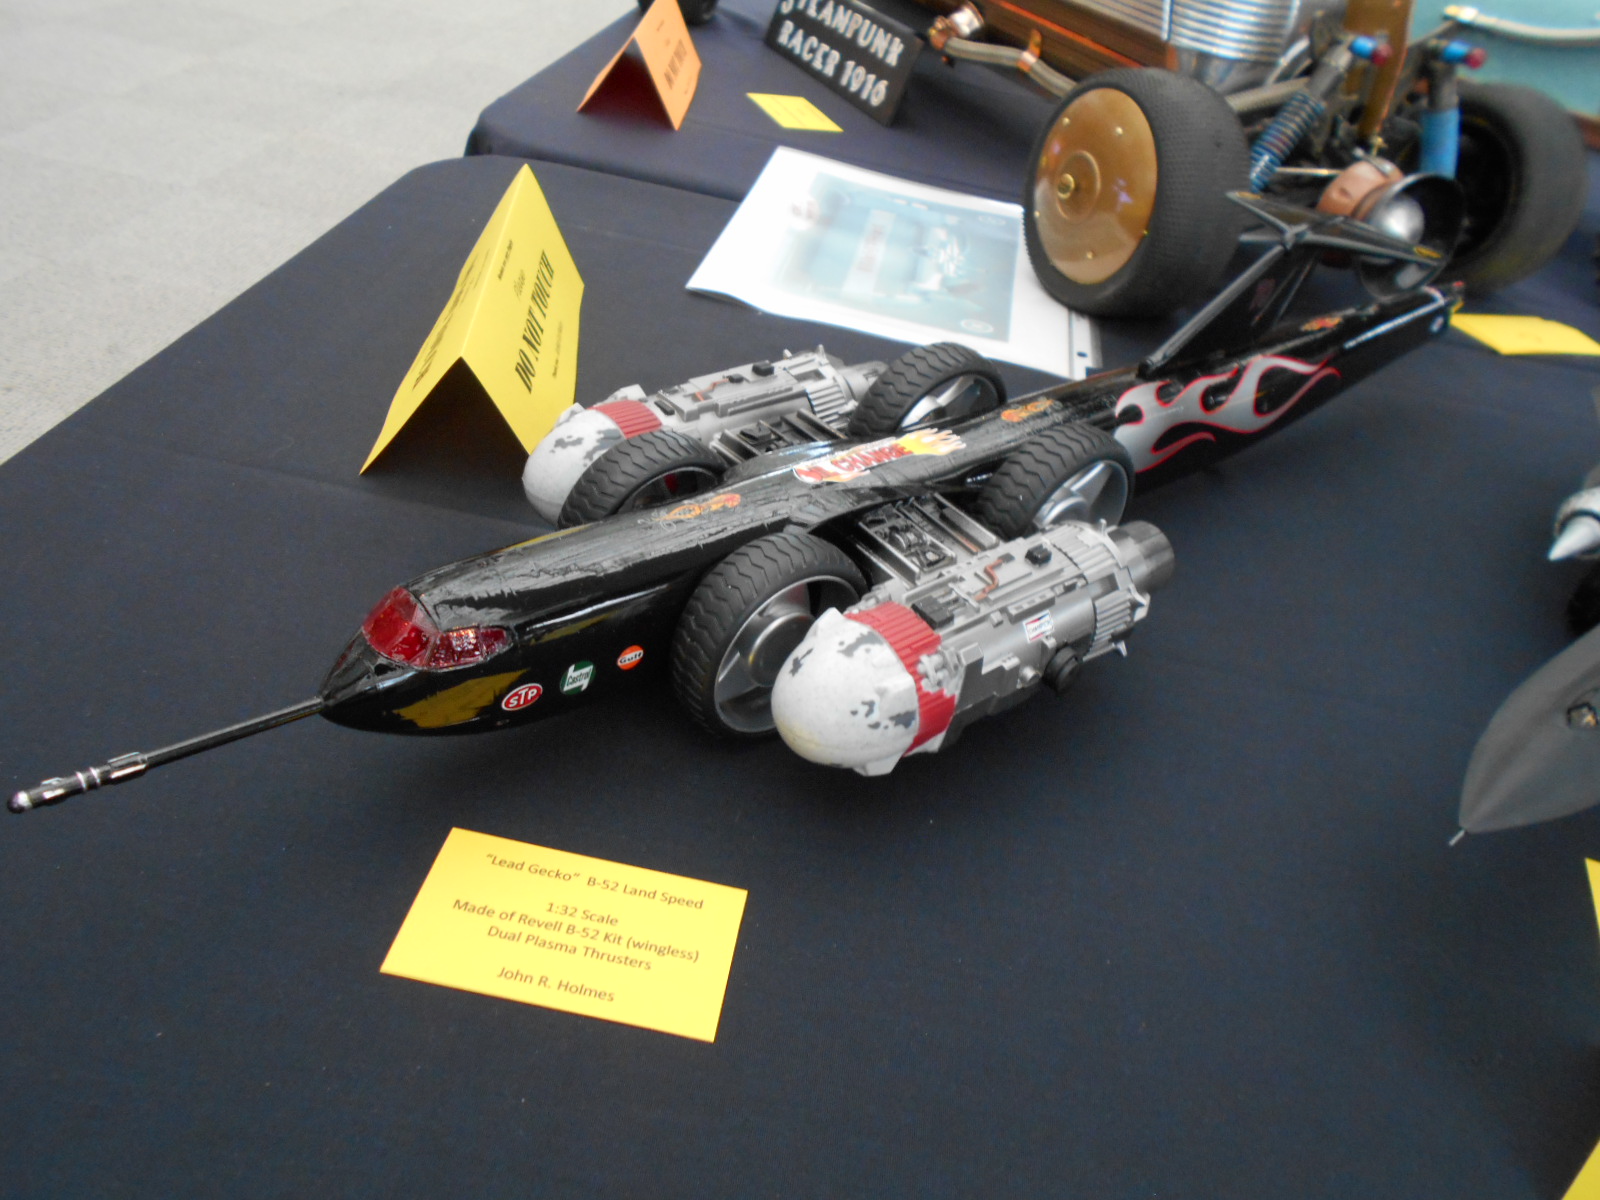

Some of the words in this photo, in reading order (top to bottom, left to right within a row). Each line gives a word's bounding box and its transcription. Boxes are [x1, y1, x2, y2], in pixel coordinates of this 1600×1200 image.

[777, 19, 841, 78] RACER
[531, 249, 555, 319] TOUCH
[522, 305, 544, 362] NOT
[515, 348, 536, 395] DO
[566, 667, 593, 687] Castrol
[619, 650, 644, 665] Gulf
[508, 686, 538, 708] STP
[587, 876, 619, 892] B-52
[623, 884, 657, 900] Land
[660, 892, 704, 910] Speed
[453, 899, 496, 918] Made
[499, 911, 517, 922] of
[518, 913, 563, 933] Revell
[565, 924, 600, 940] B-52
[603, 932, 624, 946] Kit
[626, 936, 700, 963] (wingless)
[546, 902, 578, 918] 1:32
[581, 909, 619, 926] Scale
[487, 925, 523, 942] Dual
[524, 933, 578, 955] Plasma
[583, 945, 652, 971] Thrusters
[497, 966, 534, 984] John
[537, 975, 552, 989] R.
[557, 979, 616, 1002] Holmes
